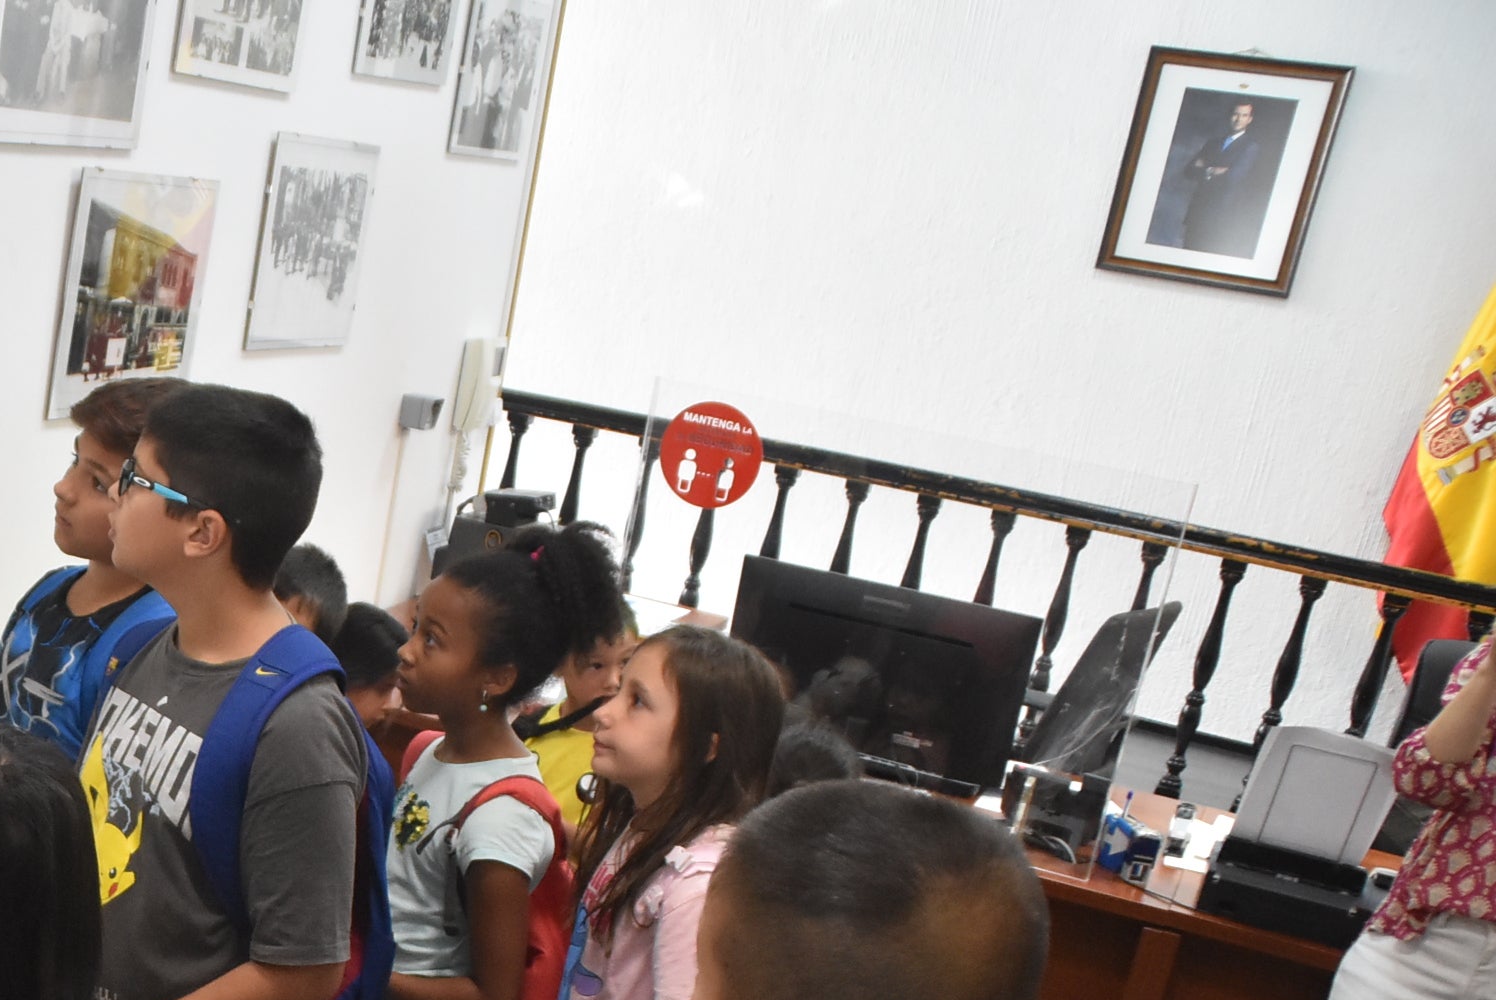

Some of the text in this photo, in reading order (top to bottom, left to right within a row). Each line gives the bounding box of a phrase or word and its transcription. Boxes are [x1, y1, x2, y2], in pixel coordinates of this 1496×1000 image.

[683, 411, 741, 433] MANTENGA
[742, 426, 753, 435] LA
[80, 686, 203, 842] OKÉMO
